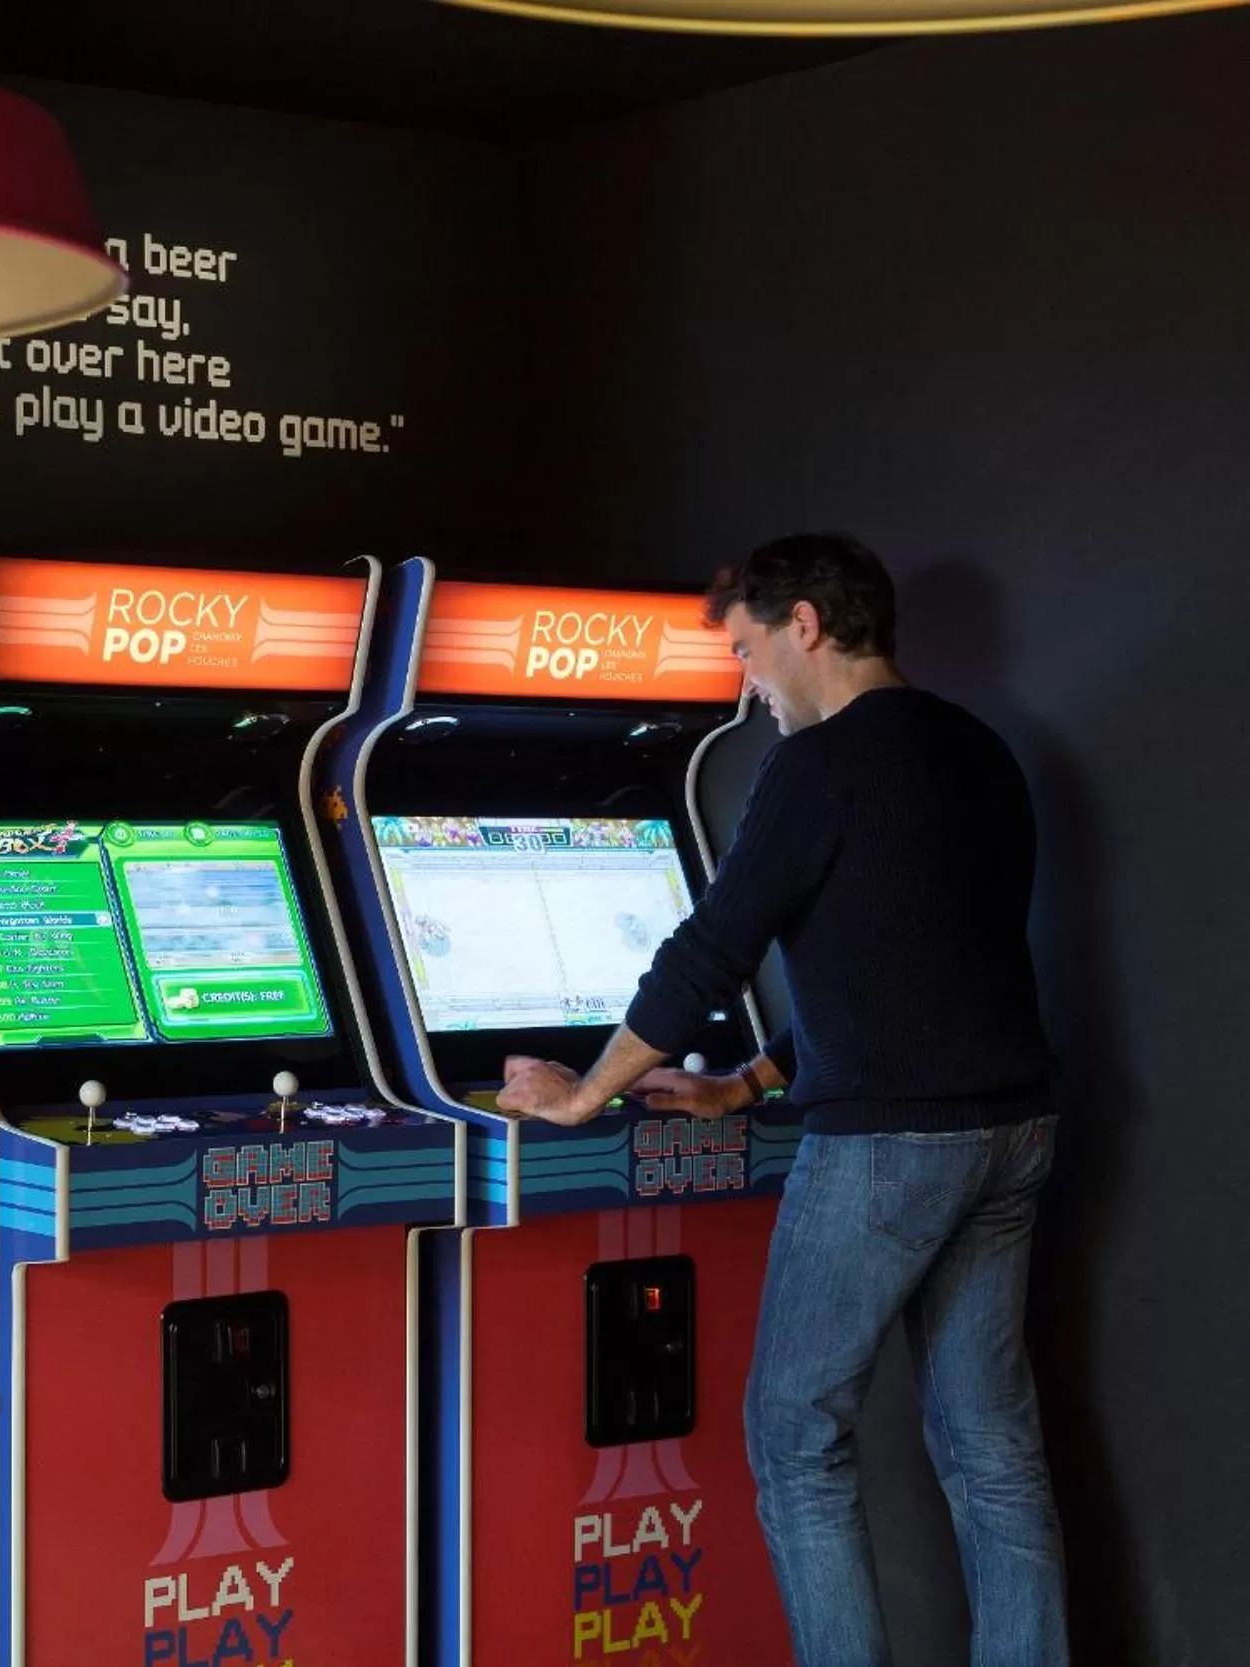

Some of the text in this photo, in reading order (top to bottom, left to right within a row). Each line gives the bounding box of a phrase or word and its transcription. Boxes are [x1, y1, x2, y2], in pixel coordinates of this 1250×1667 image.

[144, 233, 237, 282] beer
[106, 294, 190, 340] say,
[26, 339, 124, 378] over
[137, 340, 231, 388] here
[16, 385, 104, 442] play
[118, 400, 145, 435] a
[159, 398, 266, 442] video
[107, 588, 249, 629] ROCKY
[531, 610, 654, 647] ROCKY
[103, 628, 188, 664] POP
[526, 647, 600, 679] POP
[634, 1115, 748, 1157] GAME
[202, 1139, 334, 1187] GAME
[636, 1152, 745, 1197] OVER
[203, 1181, 332, 1230] OVER
[574, 1499, 702, 1563] PLAY
[145, 1556, 294, 1628] PLAY
[574, 1548, 702, 1612] PLAY
[145, 1609, 294, 1667] PLAY
[574, 1593, 702, 1660] PLAY
